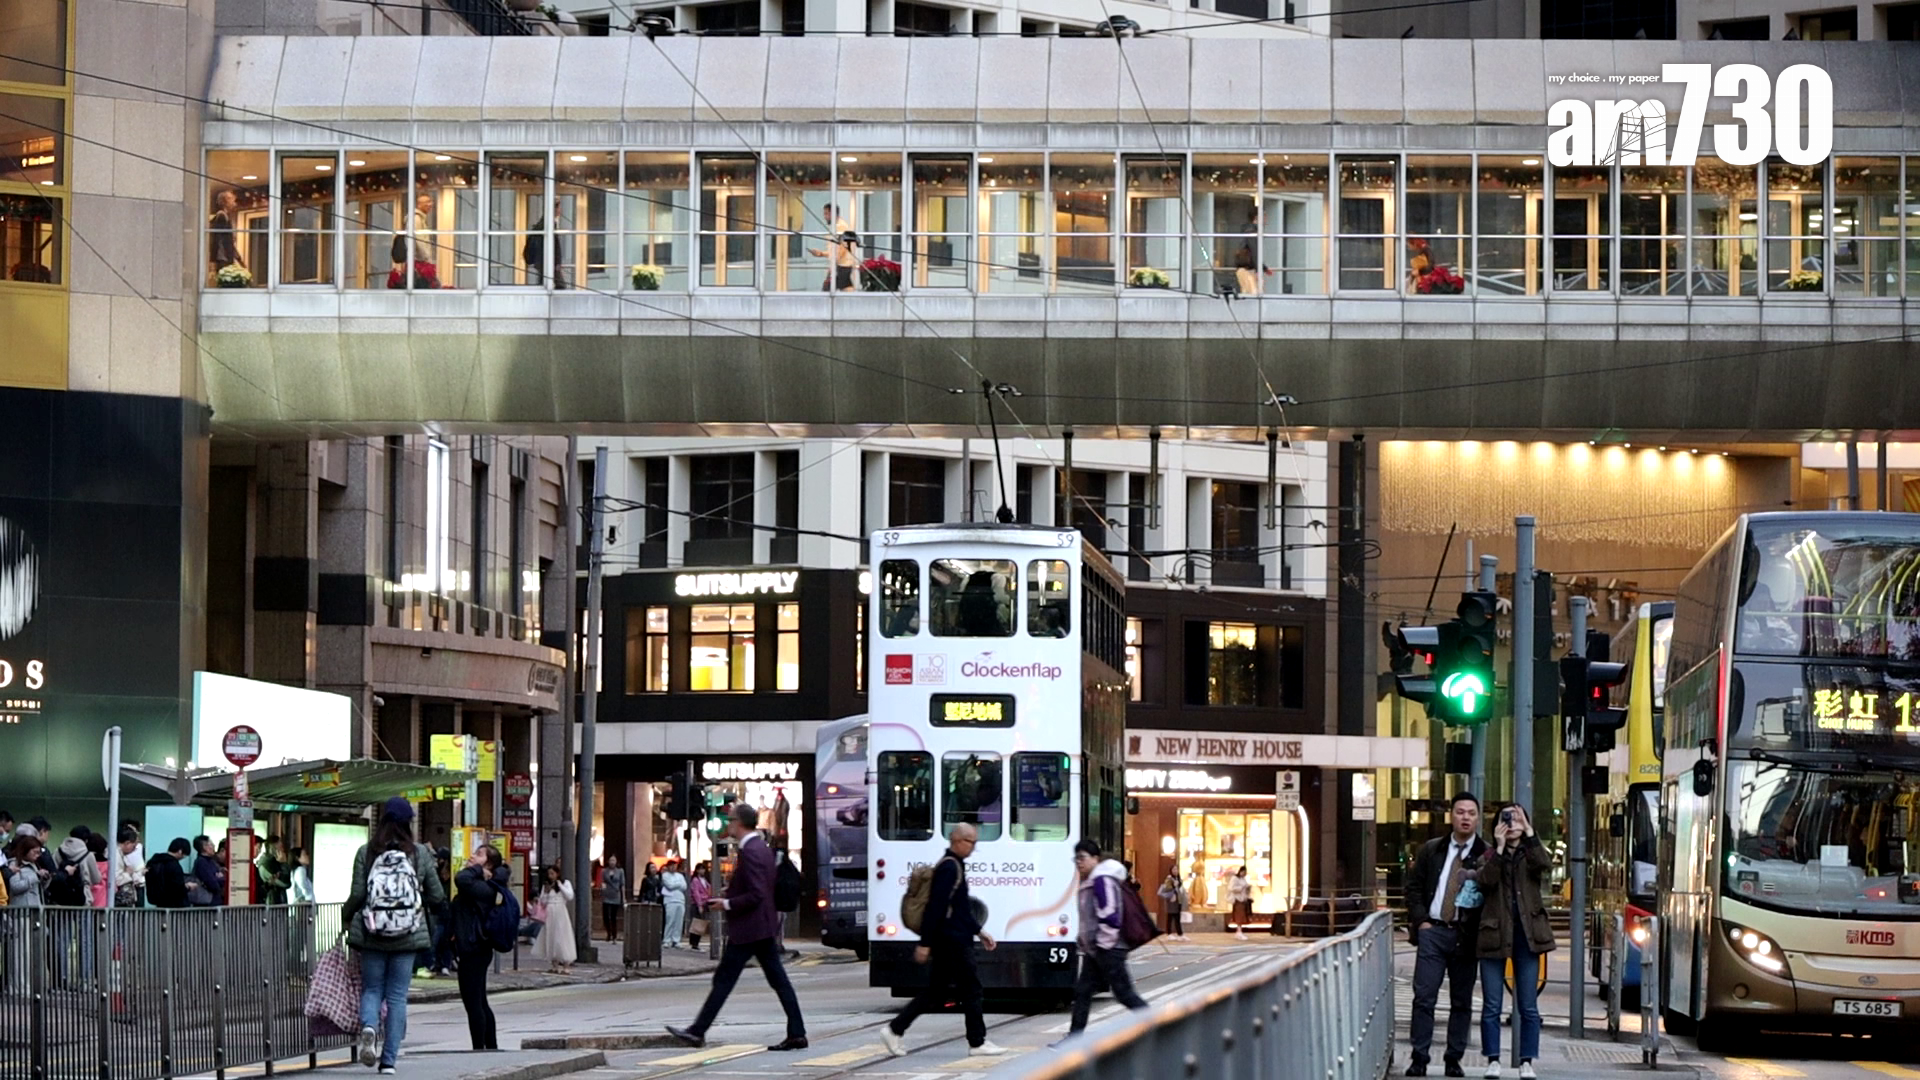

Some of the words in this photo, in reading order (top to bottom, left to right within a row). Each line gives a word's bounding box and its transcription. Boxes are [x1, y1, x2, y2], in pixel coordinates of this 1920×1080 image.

[883, 532, 899, 546] 59
[1056, 533, 1074, 547] 59
[675, 571, 799, 596] SUITSUPPLY
[961, 661, 1062, 681] Clockenflap
[1813, 689, 1879, 719] 彩虹
[1156, 736, 1192, 756] NEW
[1197, 738, 1247, 757] HENRY
[1252, 739, 1304, 759] HOUSE
[702, 761, 799, 780] SUITSUPPLY
[1125, 768, 1167, 789] DUTY
[963, 862, 987, 872] DEC
[1001, 862, 1035, 873] 2024
[968, 876, 1044, 887] RBOURFRONT
[1859, 930, 1896, 946] KMB
[1048, 947, 1069, 963] 59
[1842, 1001, 1861, 1013] TS
[1865, 1002, 1893, 1015] 685
